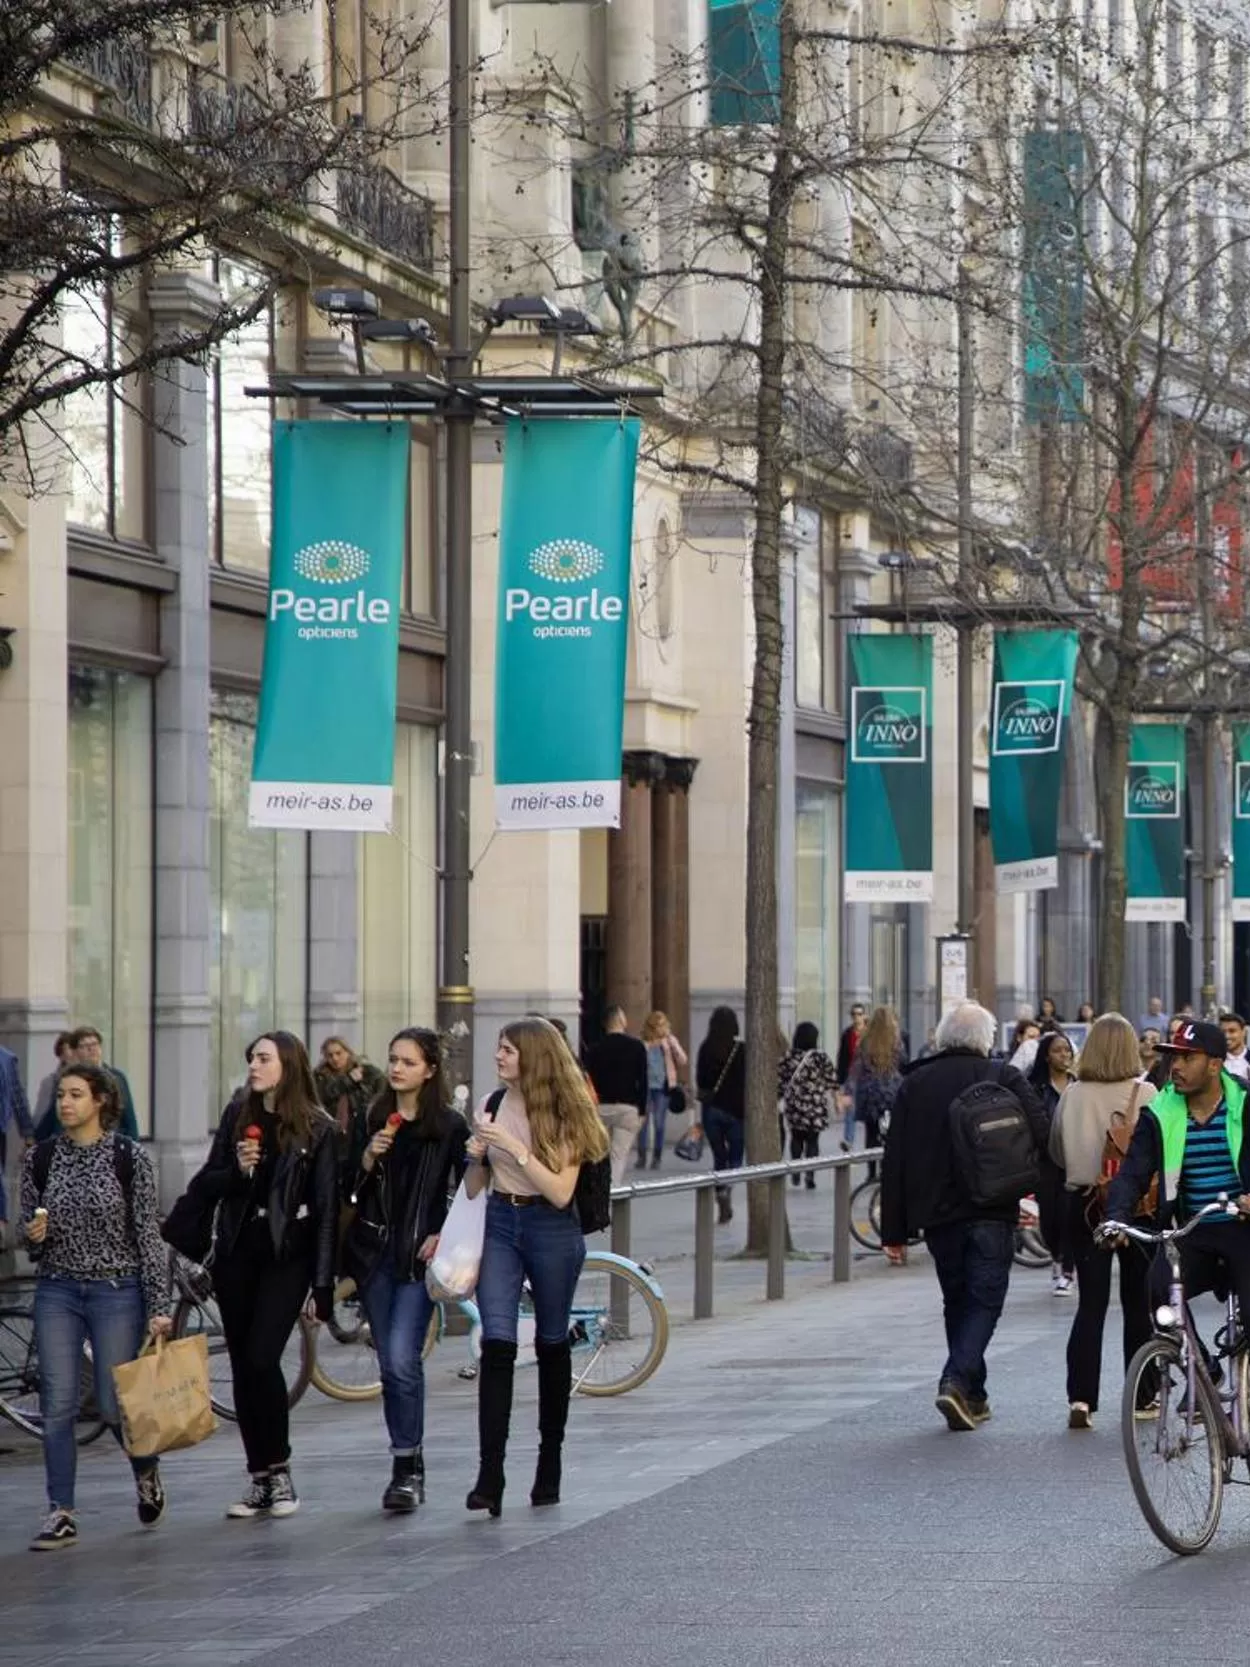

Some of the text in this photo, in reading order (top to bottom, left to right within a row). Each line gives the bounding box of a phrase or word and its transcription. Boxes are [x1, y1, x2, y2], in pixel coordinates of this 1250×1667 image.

[270, 589, 390, 624] Pearle
[505, 588, 622, 621] Pearle
[298, 626, 358, 640] opticiens
[533, 625, 592, 639] opticiens
[866, 724, 918, 742] INNO
[1006, 716, 1055, 735] INNO
[266, 793, 373, 812] meir-as.be
[511, 792, 604, 811] meir-as.be
[1134, 789, 1174, 804] INNO
